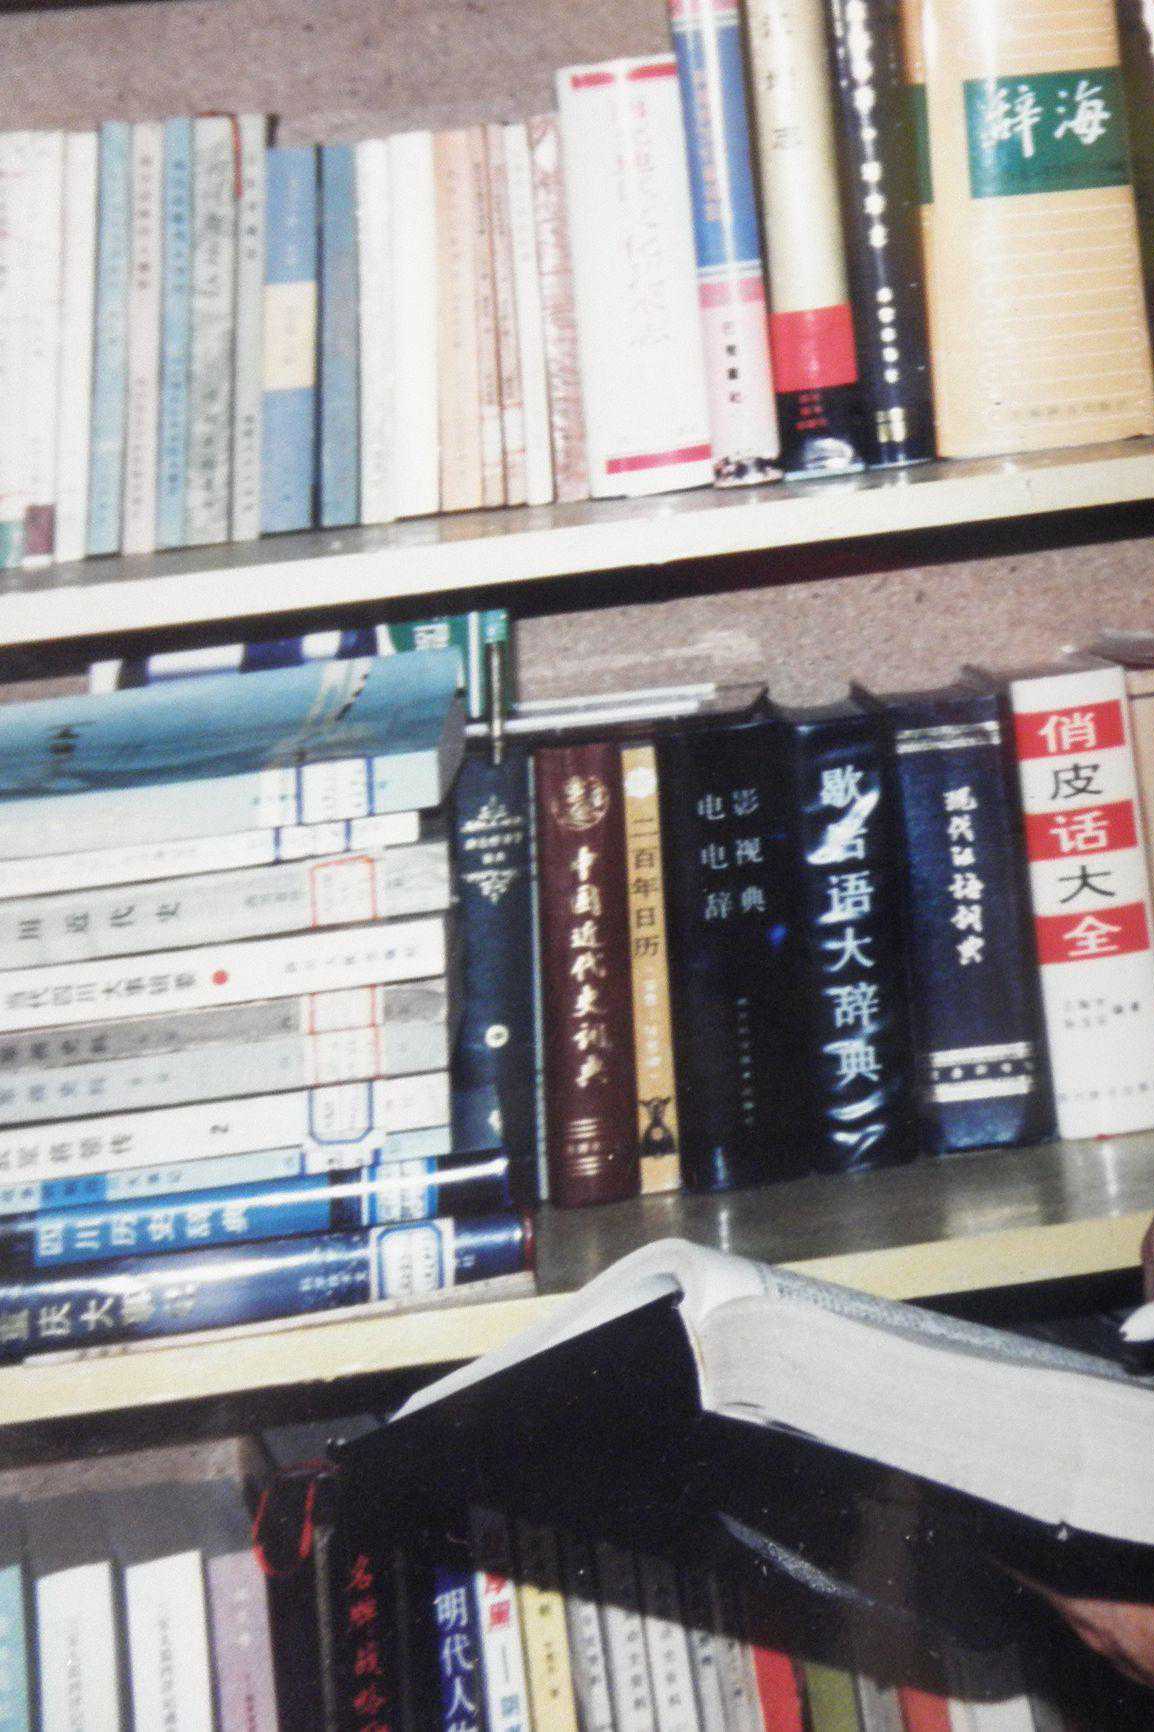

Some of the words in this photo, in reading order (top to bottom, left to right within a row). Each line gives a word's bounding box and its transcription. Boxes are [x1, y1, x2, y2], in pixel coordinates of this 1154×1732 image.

[697, 787, 761, 820] 电影
[700, 837, 764, 870] 电视
[1038, 712, 1122, 958] 俏皮话大全
[629, 817, 664, 957] 二百年日历
[704, 884, 766, 921] 辞典
